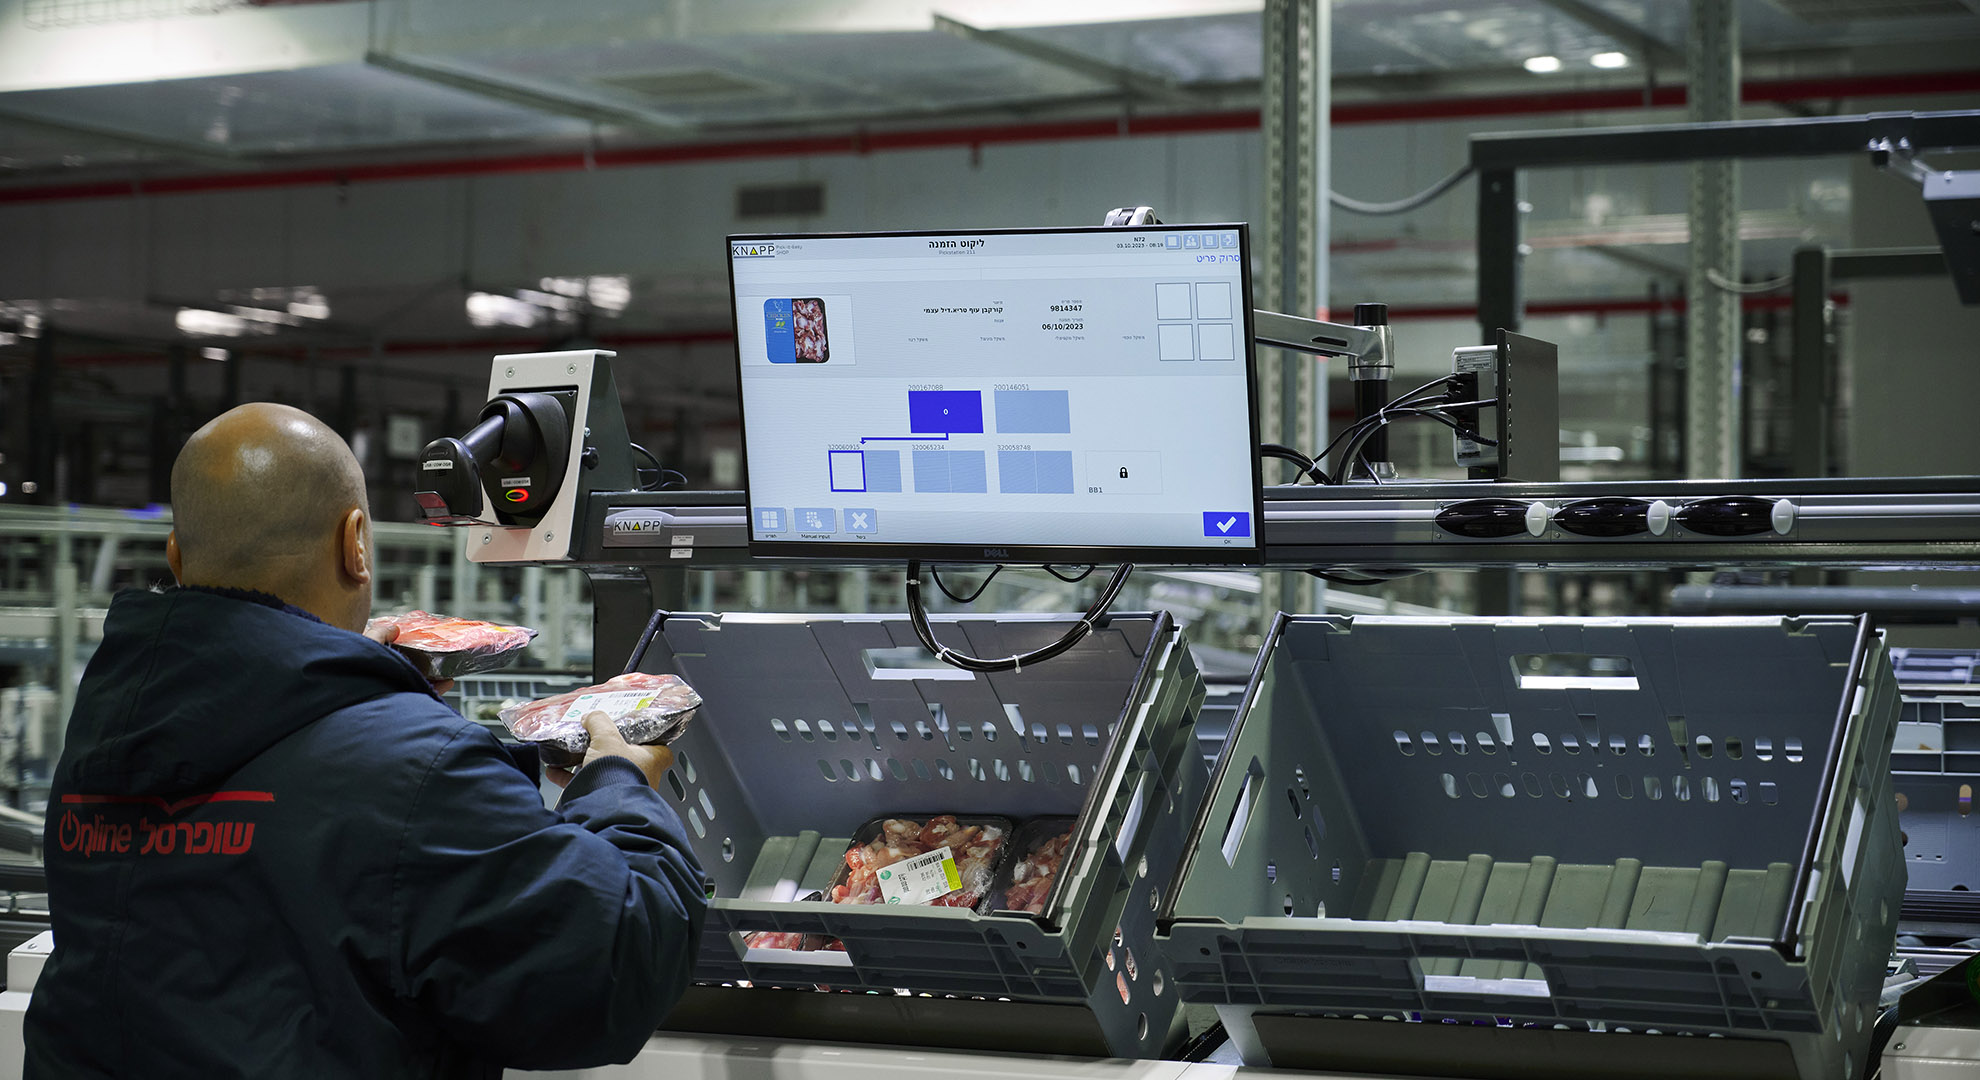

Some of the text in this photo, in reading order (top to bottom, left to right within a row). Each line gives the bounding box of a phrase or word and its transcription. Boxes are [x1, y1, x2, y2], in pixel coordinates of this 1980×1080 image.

[928, 239, 985, 249] ליקוט הזמנה
[732, 246, 775, 256] KNAPP
[1196, 254, 1241, 264] סרוק פריט
[614, 520, 661, 531] KNAPP
[983, 548, 1009, 558] DELL
[59, 809, 256, 858] שופרסל Online
